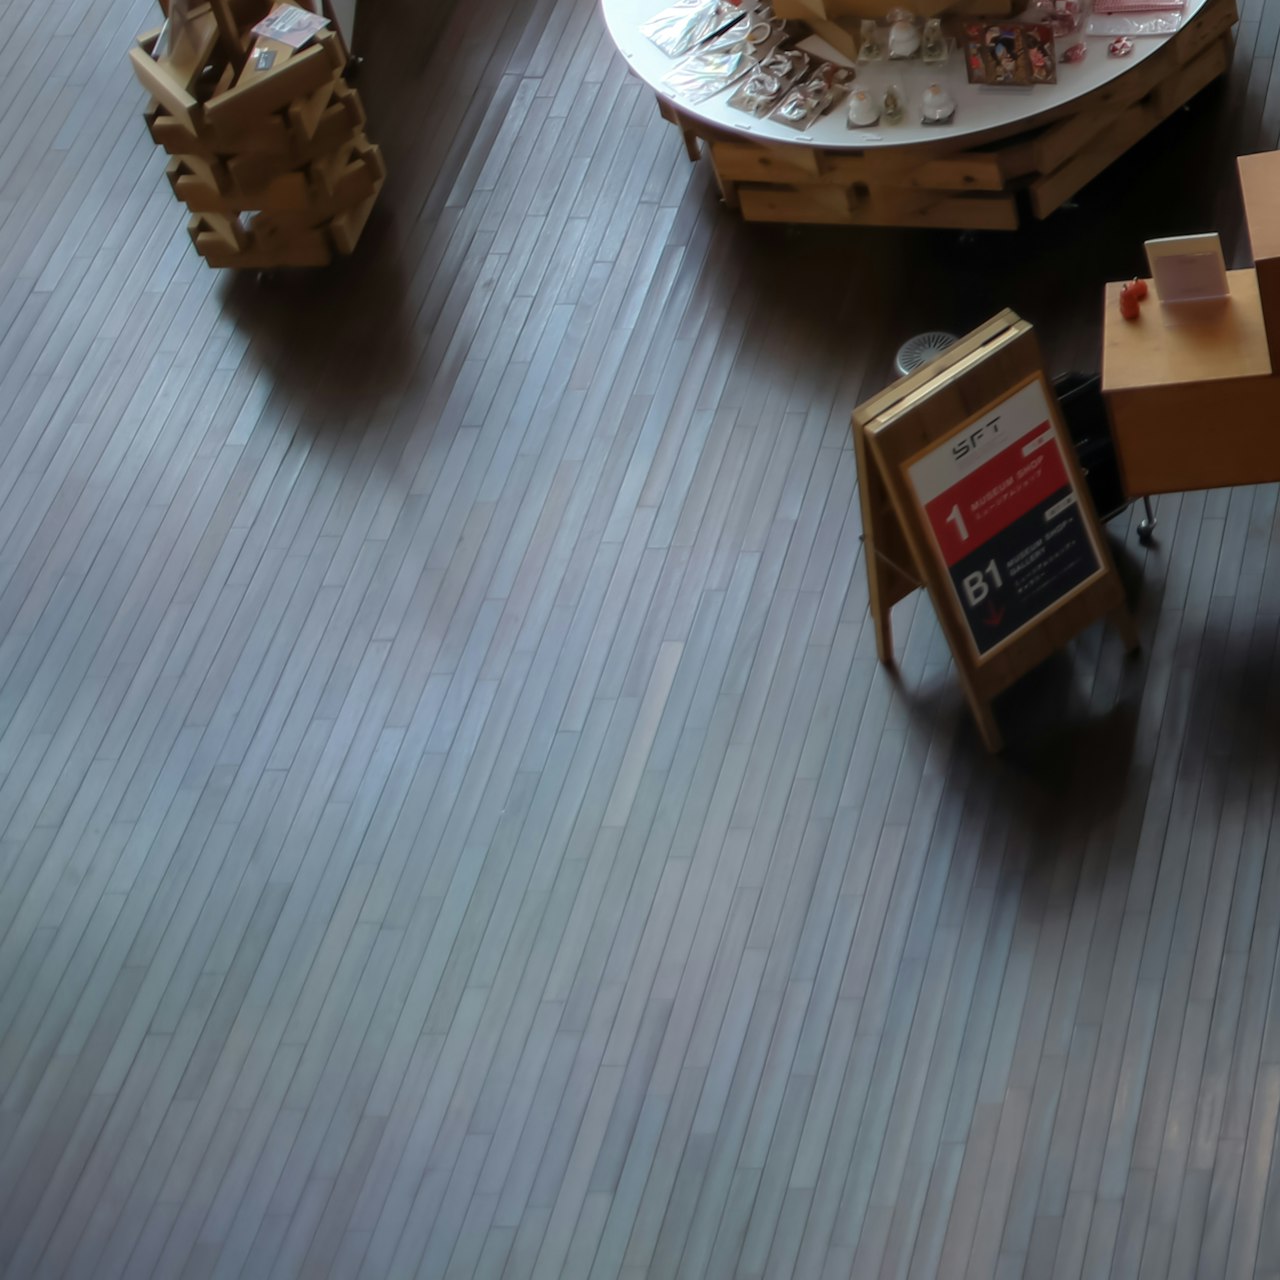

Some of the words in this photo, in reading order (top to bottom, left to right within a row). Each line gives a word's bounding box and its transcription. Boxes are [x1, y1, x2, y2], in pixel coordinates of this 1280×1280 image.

[952, 416, 1001, 460] SFT
[970, 475, 1014, 511] MUSEUM
[1014, 455, 1045, 480] SHOP
[946, 503, 969, 542] 1
[1007, 538, 1043, 568] MUSEUM
[962, 558, 1003, 607] B1
